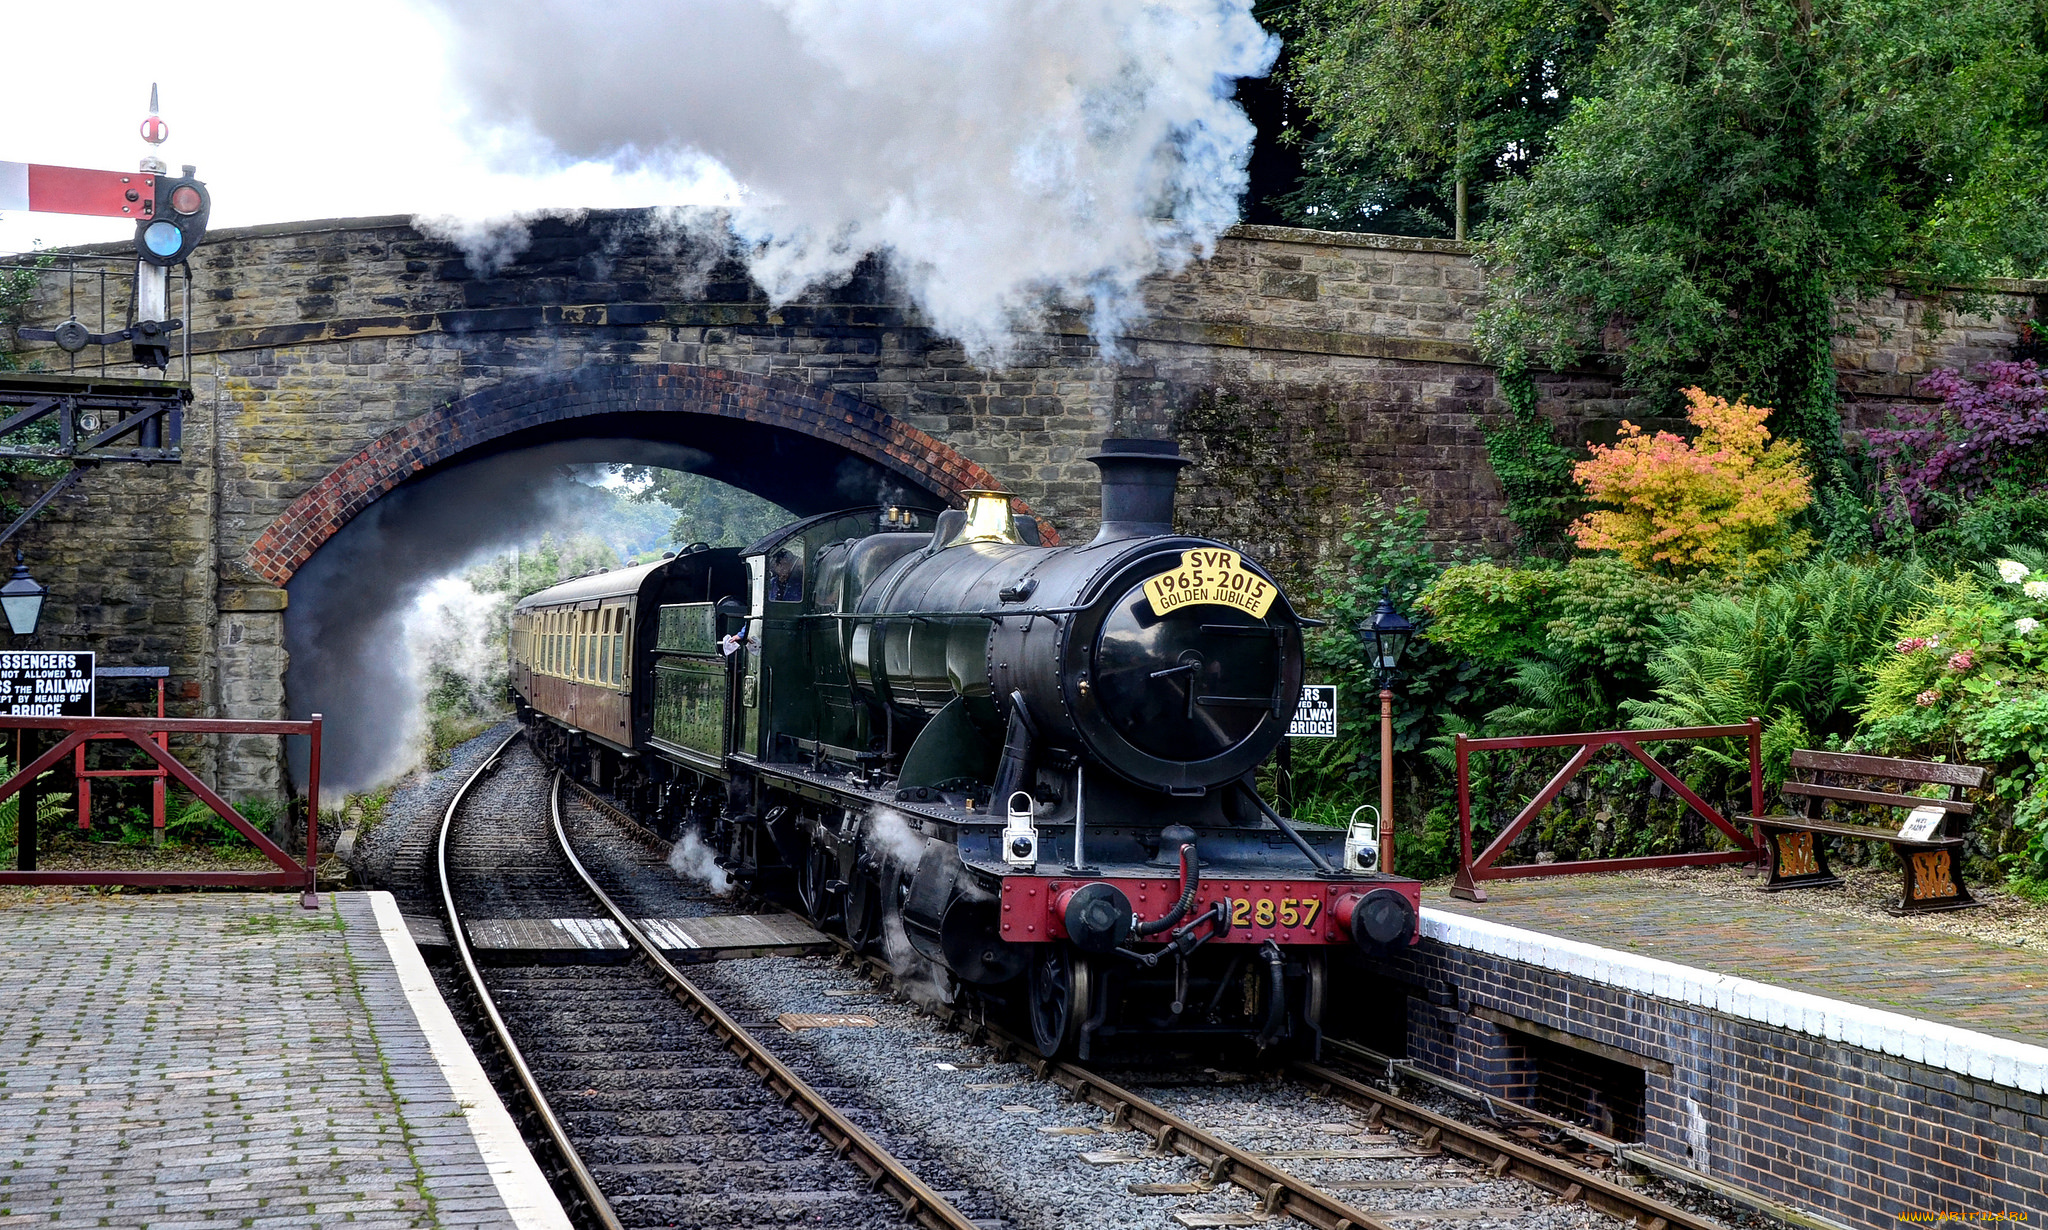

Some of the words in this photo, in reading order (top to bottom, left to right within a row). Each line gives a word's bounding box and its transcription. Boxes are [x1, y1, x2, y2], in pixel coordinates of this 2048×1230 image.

[1191, 552, 1231, 569] SVR
[1154, 570, 1267, 598] 1965-2015
[1160, 588, 1208, 609] GOLDEN
[1213, 588, 1261, 612] JUBILEE
[0, 655, 76, 669] SSENGERS
[1, 670, 20, 678] NOT
[24, 670, 66, 678] ALLOWED
[71, 670, 82, 678] TO
[14, 685, 32, 694] THE
[35, 679, 91, 693] RAILWAY
[18, 695, 29, 703] BY
[34, 694, 65, 703] MEANS
[70, 694, 81, 702] OF
[11, 704, 62, 716] BRIDGE
[1293, 708, 1333, 721] AILWAY
[1290, 721, 1333, 734] BRIDGE
[1232, 898, 1321, 927] 2857
